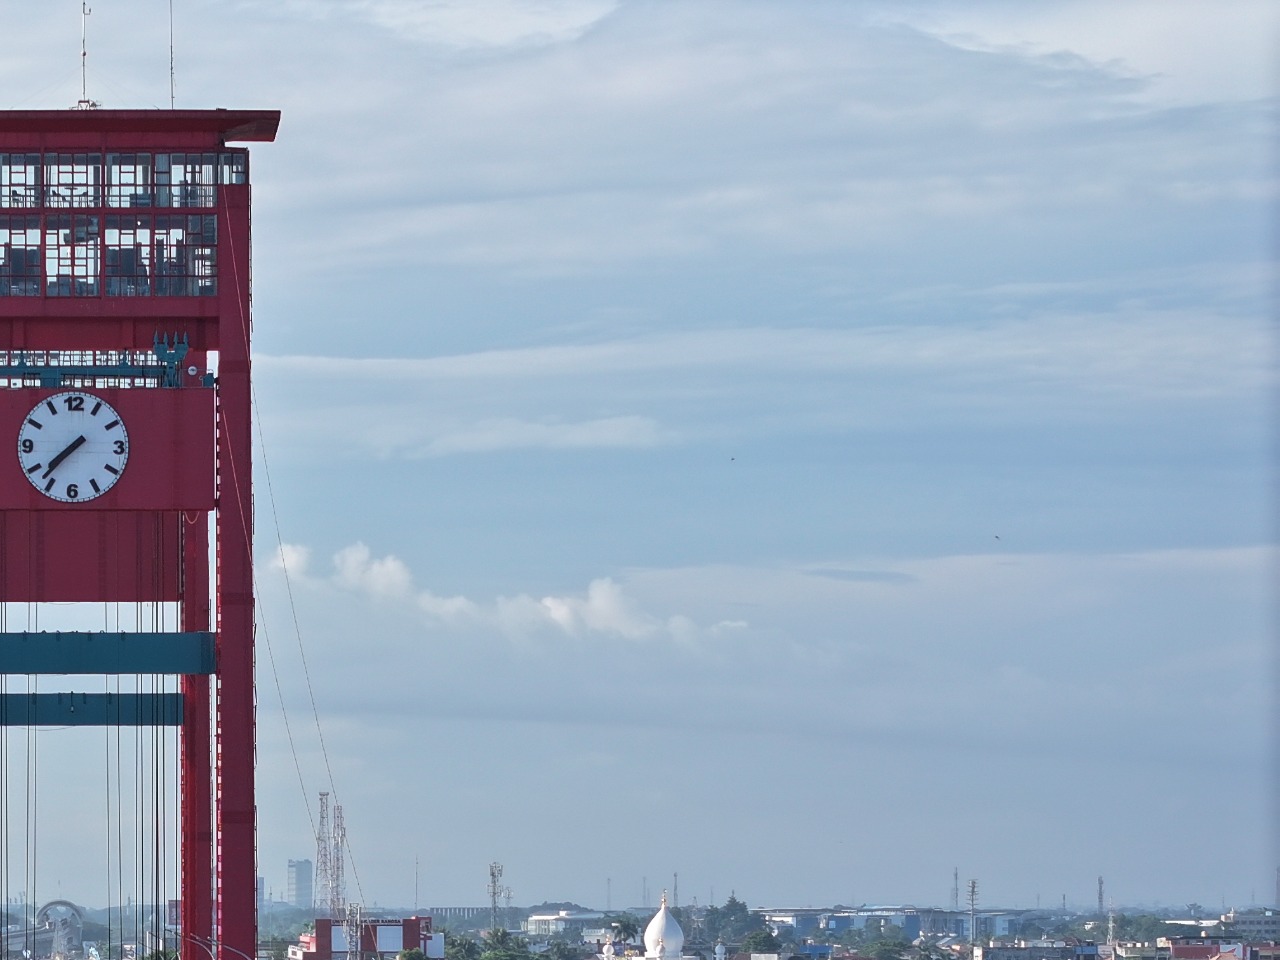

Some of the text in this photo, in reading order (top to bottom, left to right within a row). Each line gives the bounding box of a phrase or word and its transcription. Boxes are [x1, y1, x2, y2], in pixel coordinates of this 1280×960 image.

[64, 396, 84, 411] 12
[22, 439, 33, 453] 9
[113, 440, 125, 455] 3
[66, 484, 79, 498] 6
